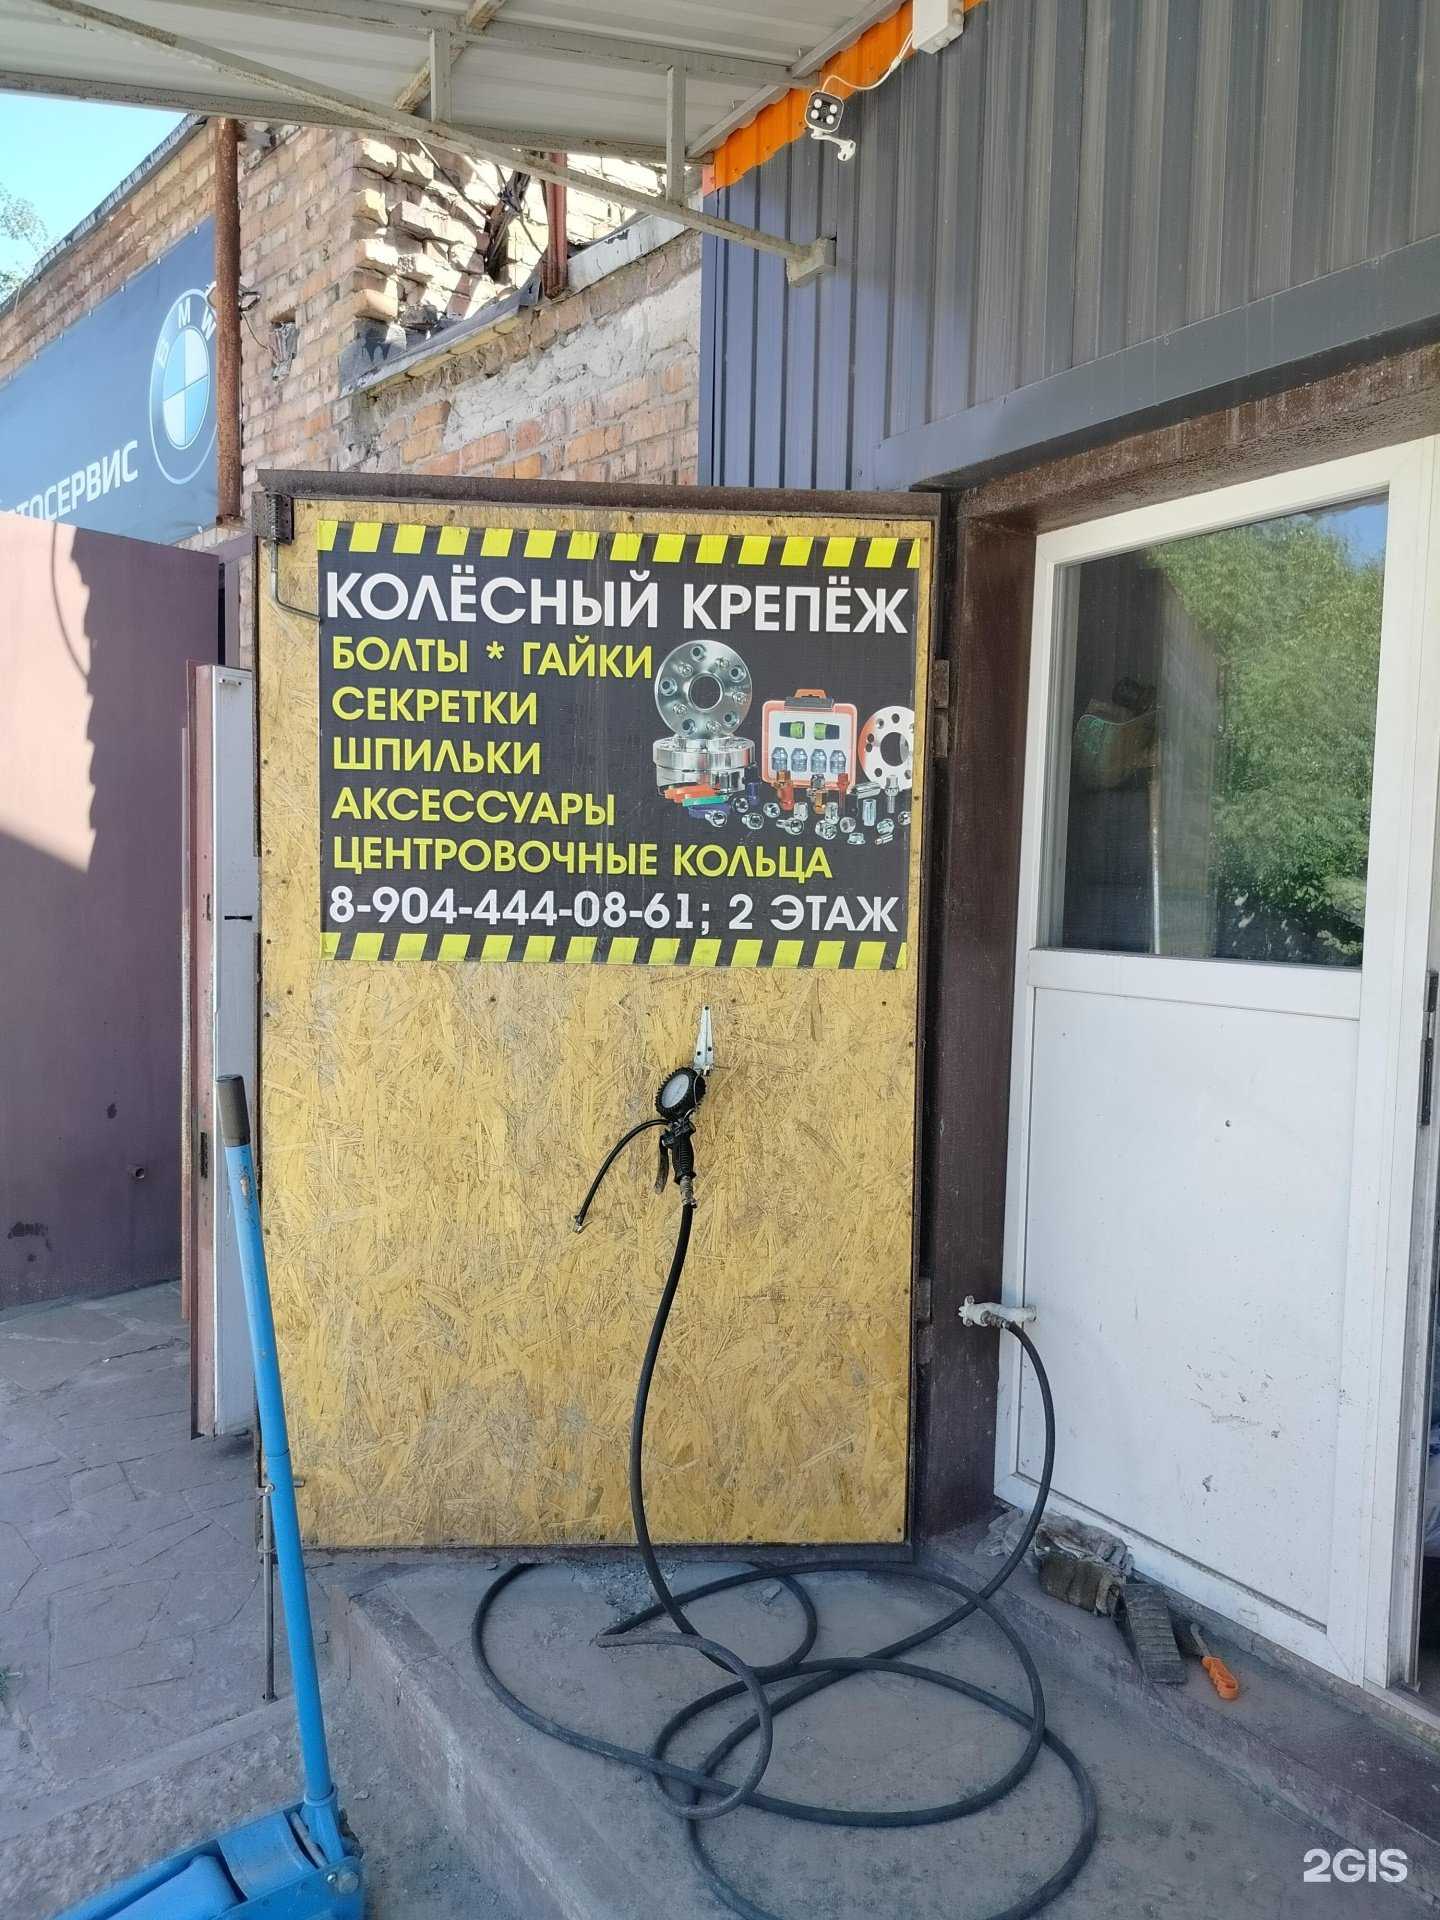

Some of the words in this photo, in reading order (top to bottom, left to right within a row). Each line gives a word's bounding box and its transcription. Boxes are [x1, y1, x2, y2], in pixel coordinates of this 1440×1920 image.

[7, 440, 138, 521] ТОСЕРВИС
[327, 564, 658, 628] КОЛЁСНЫЙ
[684, 576, 909, 633] КРЕПЁЖ
[332, 636, 468, 673] БОЛТЫ
[522, 635, 653, 678] ГАЙКИ
[332, 687, 537, 725] СЕКРЕТКИ
[333, 737, 541, 775] ШПИЛЬКИ
[331, 787, 615, 826] АКСЕССУАРЫ
[333, 836, 658, 876] ЦЕНТРОВОЧНЫЕ
[674, 844, 833, 884] КОЛЬЦА
[329, 886, 710, 935] 8-904-444-08-61;
[729, 894, 753, 930] 2
[770, 894, 899, 933] ЭТАЖ
